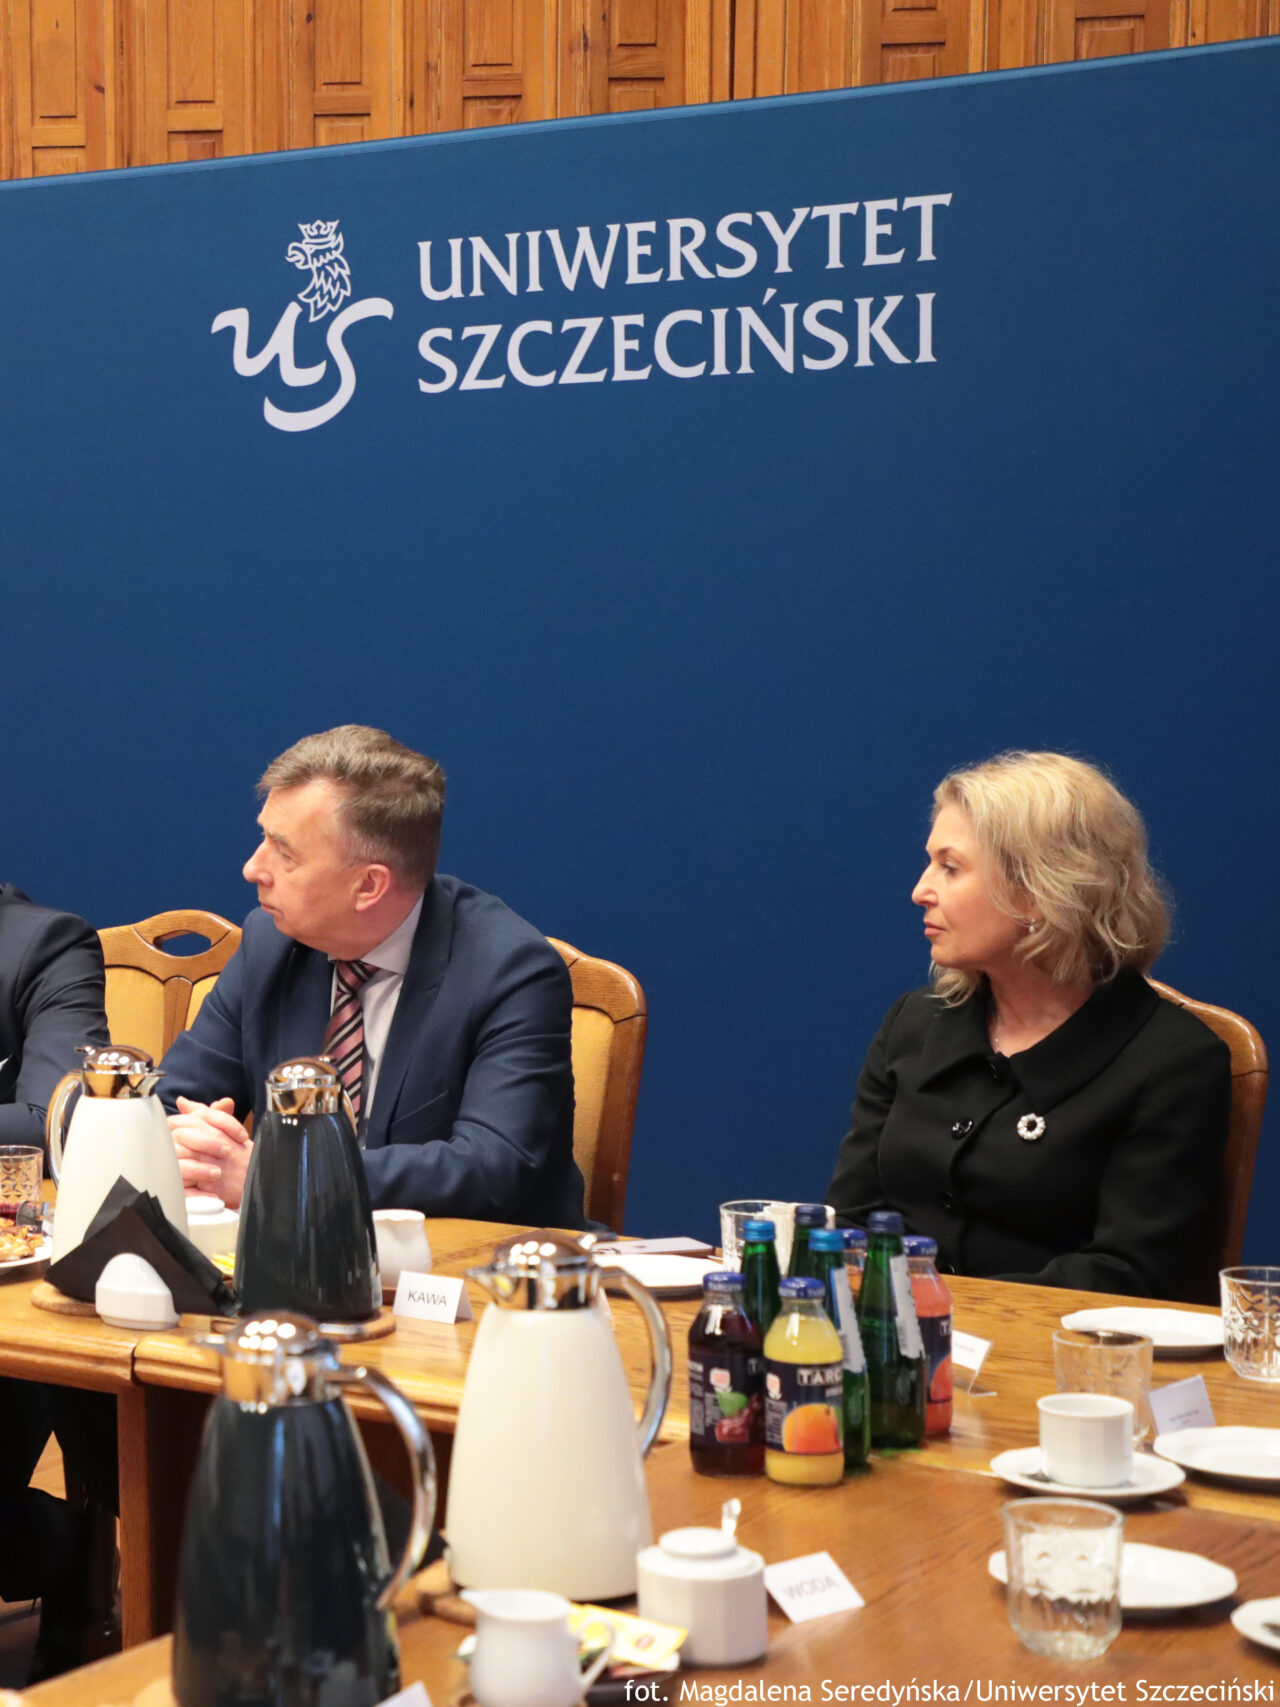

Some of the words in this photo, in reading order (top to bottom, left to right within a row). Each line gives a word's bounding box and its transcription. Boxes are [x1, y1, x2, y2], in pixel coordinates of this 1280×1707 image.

[417, 193, 953, 302] UNIWERSYTET
[418, 287, 937, 394] SZCZECIŃSKI
[407, 1289, 448, 1307] KAWA
[782, 1575, 840, 1600] WODA
